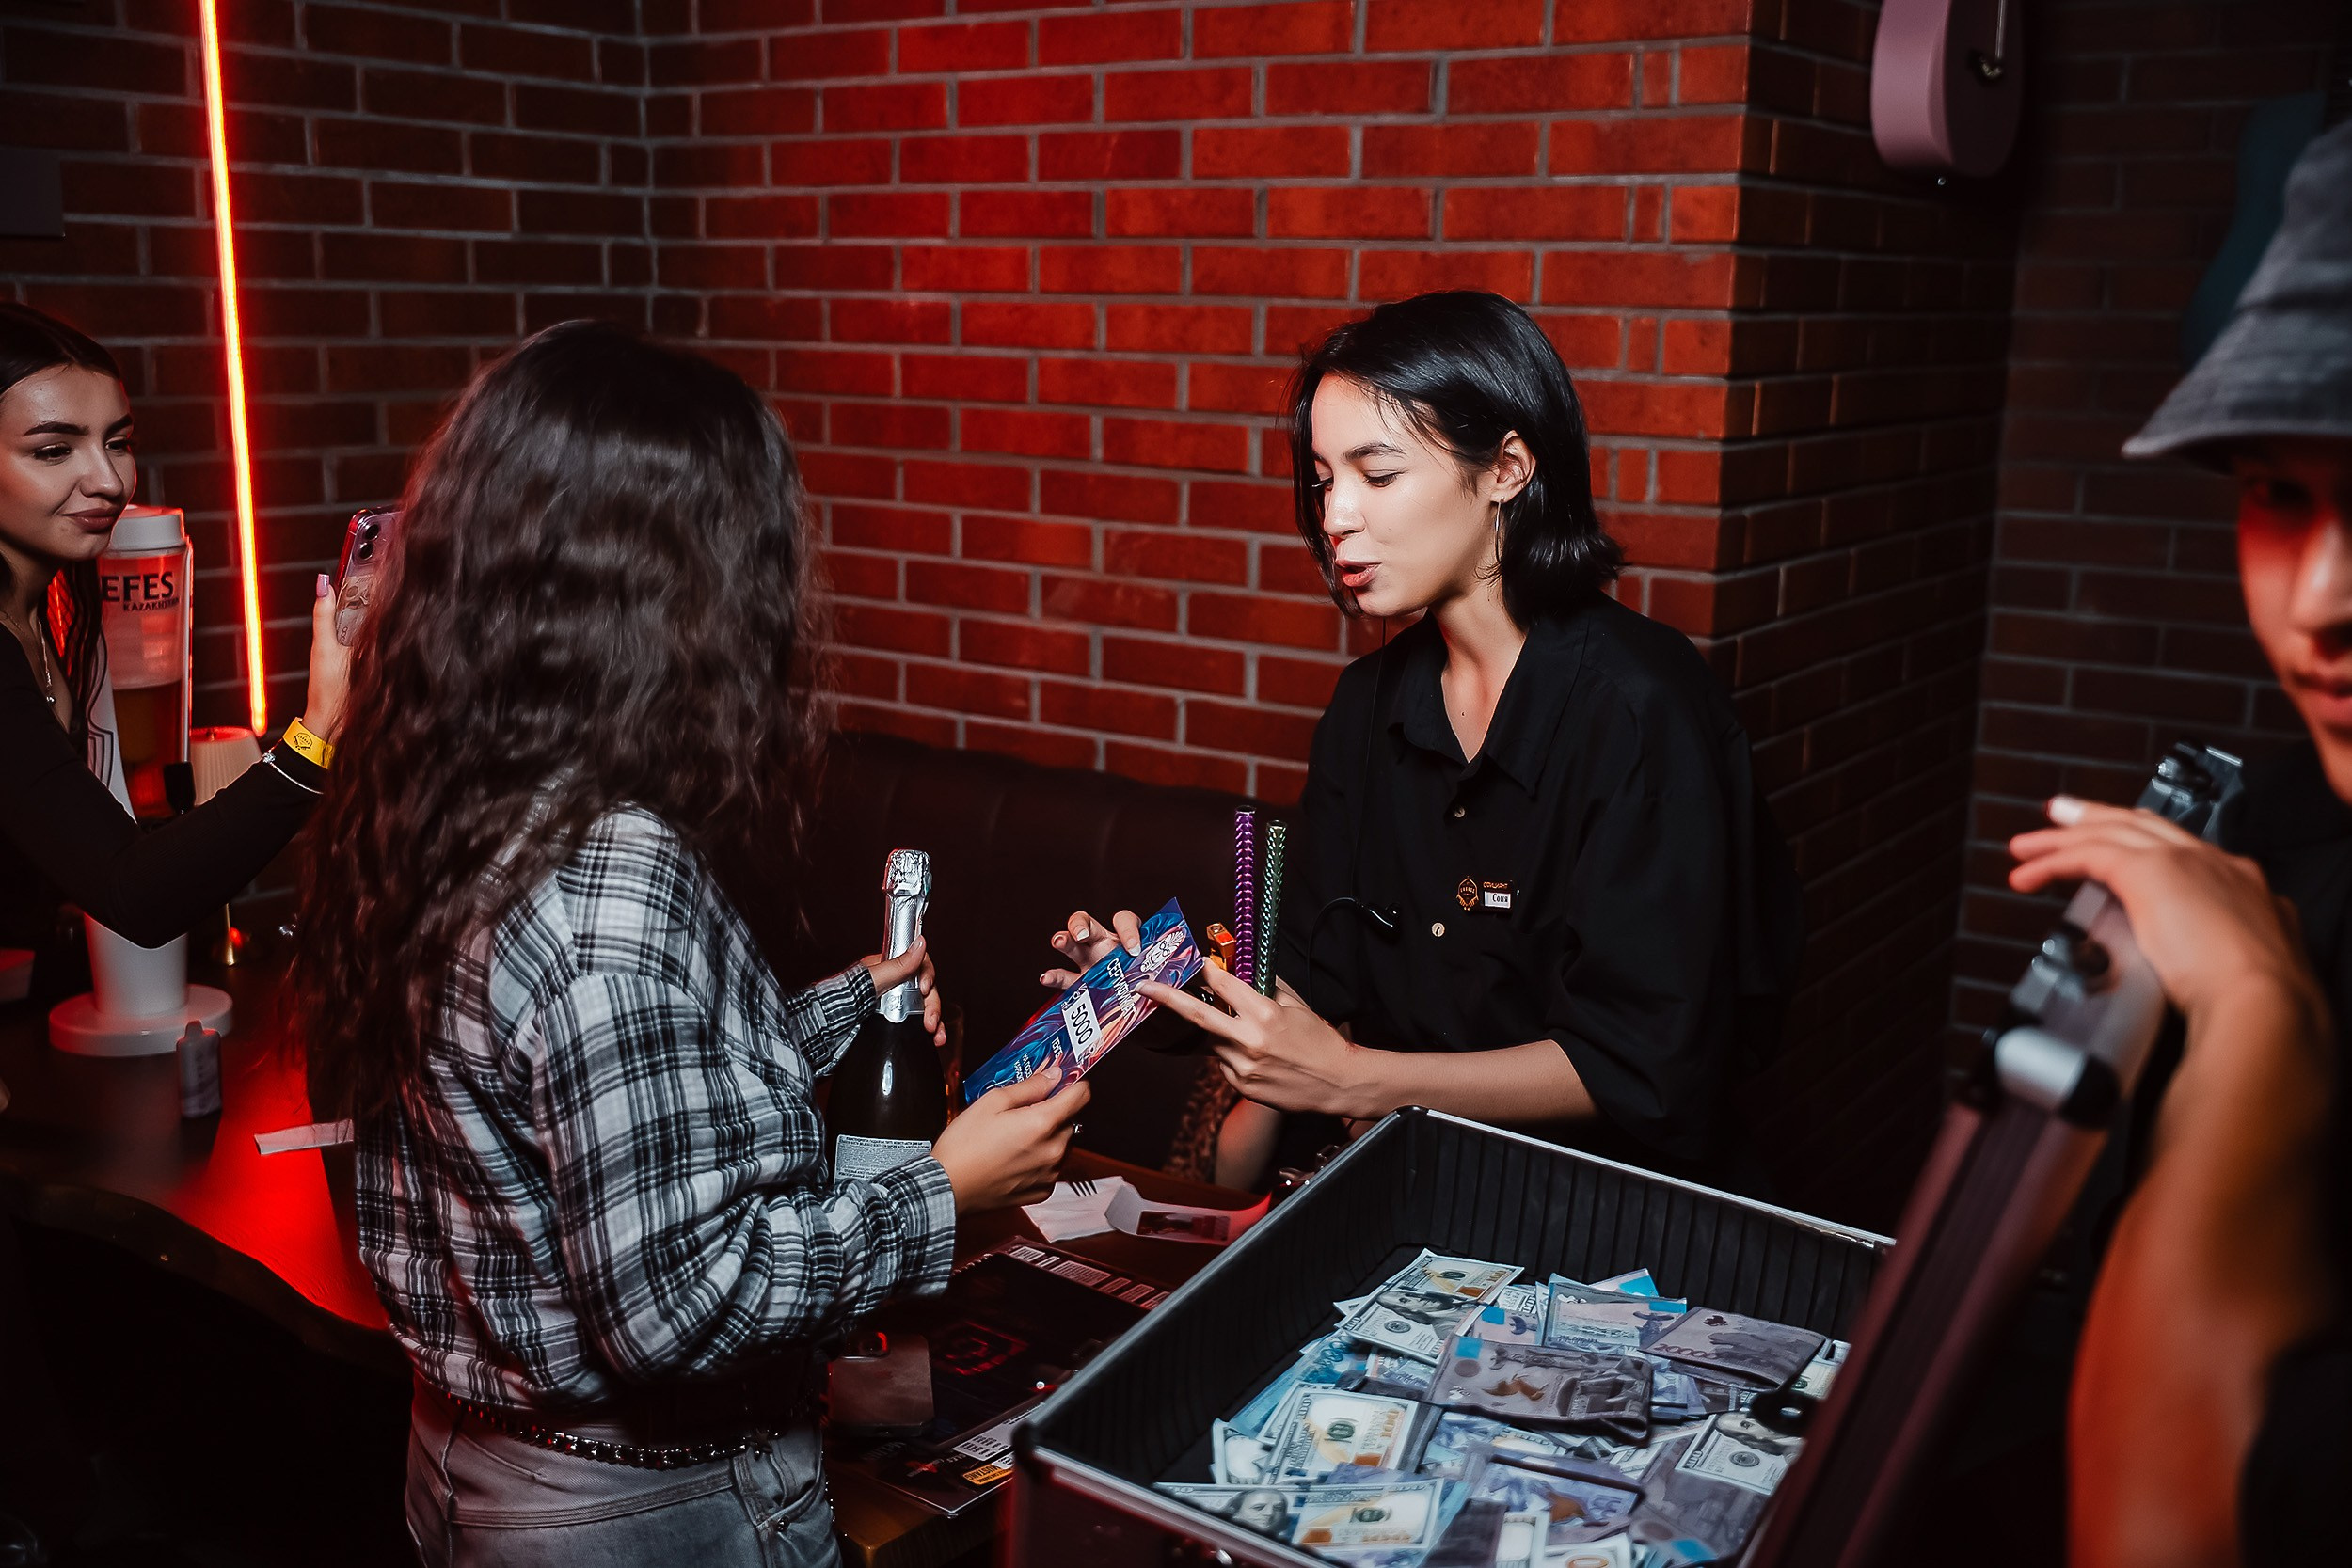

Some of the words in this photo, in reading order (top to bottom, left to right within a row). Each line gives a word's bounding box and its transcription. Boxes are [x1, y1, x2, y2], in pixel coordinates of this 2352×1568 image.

[102, 572, 173, 602] EFES
[1107, 958, 1137, 1019] СЕРТИФИКАТ
[1071, 1003, 1093, 1045] 5000
